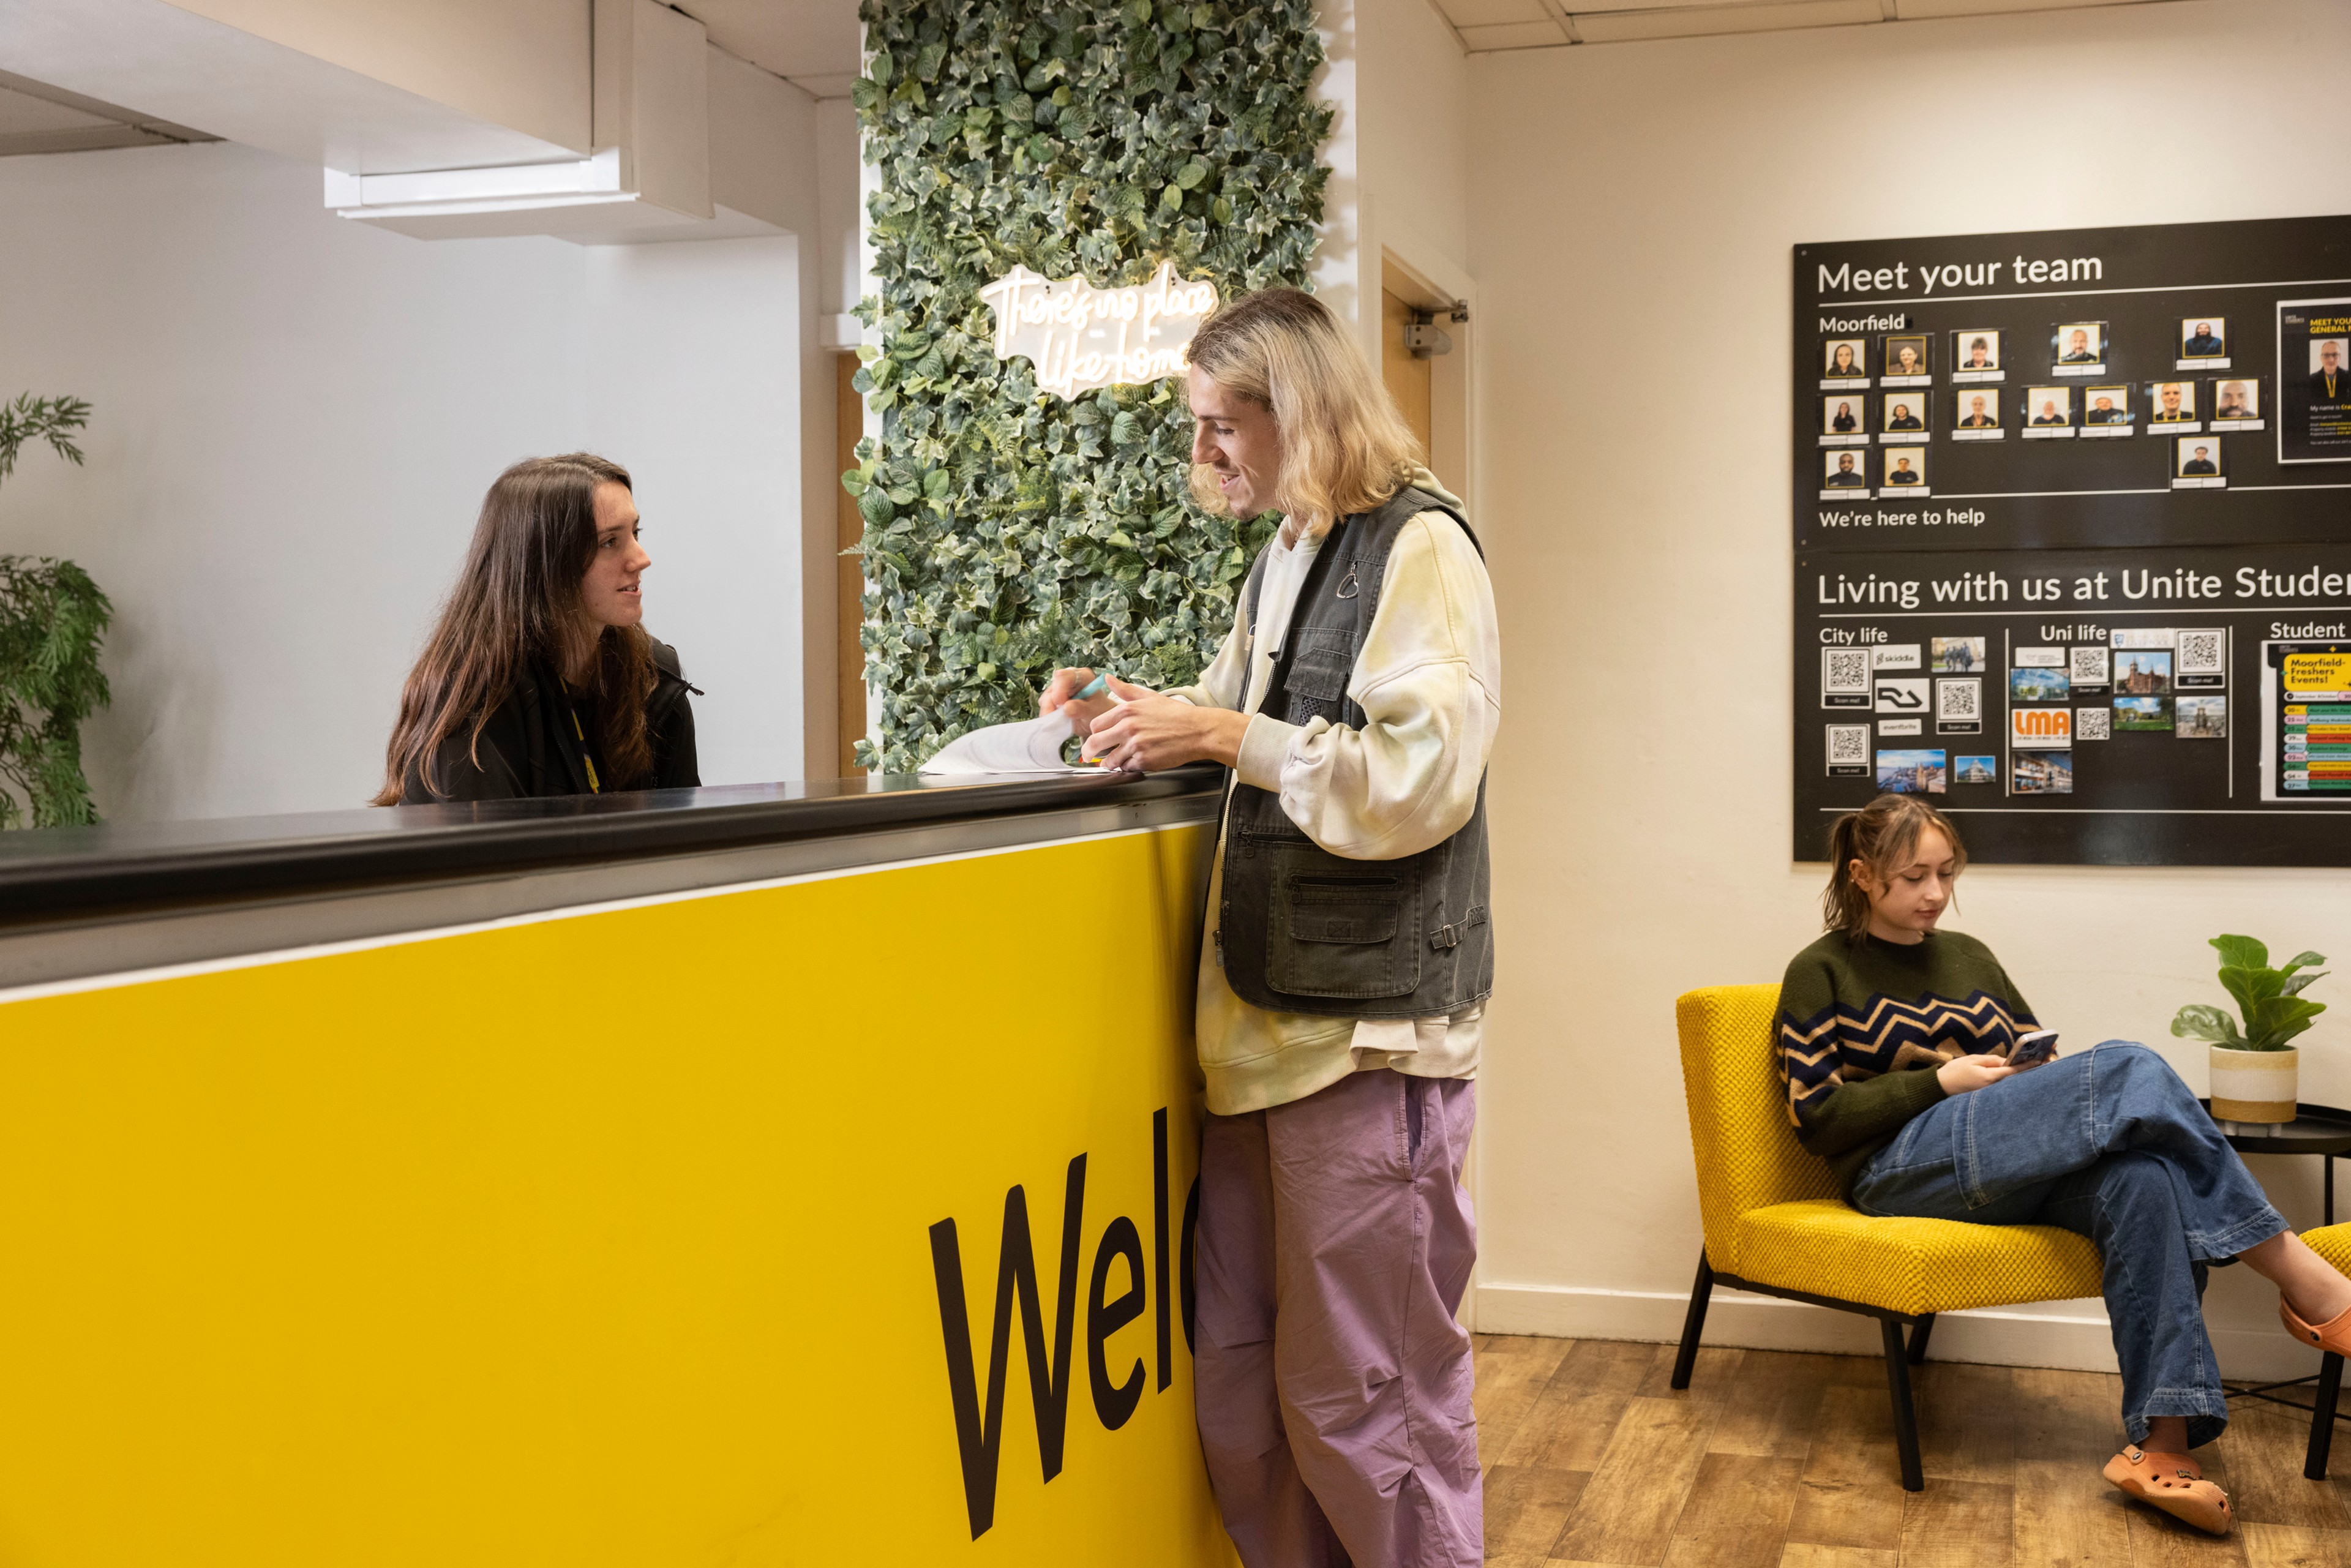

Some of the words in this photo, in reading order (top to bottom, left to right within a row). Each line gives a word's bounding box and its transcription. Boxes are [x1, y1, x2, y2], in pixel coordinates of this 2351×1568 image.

[1818, 261, 1909, 293] Meet
[1919, 262, 2002, 294] your
[2012, 255, 2102, 284] team
[983, 268, 1091, 355] There's
[1095, 289, 1139, 321] no
[1143, 263, 1213, 343] place
[1819, 312, 1905, 333] Moorfield
[2309, 318, 2332, 326] MEET
[2309, 325, 2346, 334] GENERAL
[1818, 510, 1872, 527] We're
[1877, 509, 1918, 527] here
[1922, 510, 1941, 526] to
[1946, 508, 1985, 527] help
[1818, 574, 1920, 609] Living
[1931, 571, 2009, 602] with
[2022, 578, 2061, 601] us
[2073, 571, 2109, 600] at
[2122, 568, 2222, 599] Unite
[2235, 565, 2351, 598] Stude
[1819, 627, 1858, 645] City
[1860, 627, 1888, 643] life
[2041, 625, 2072, 641] Uni
[2078, 624, 2107, 640] life
[2270, 621, 2346, 639] Student
